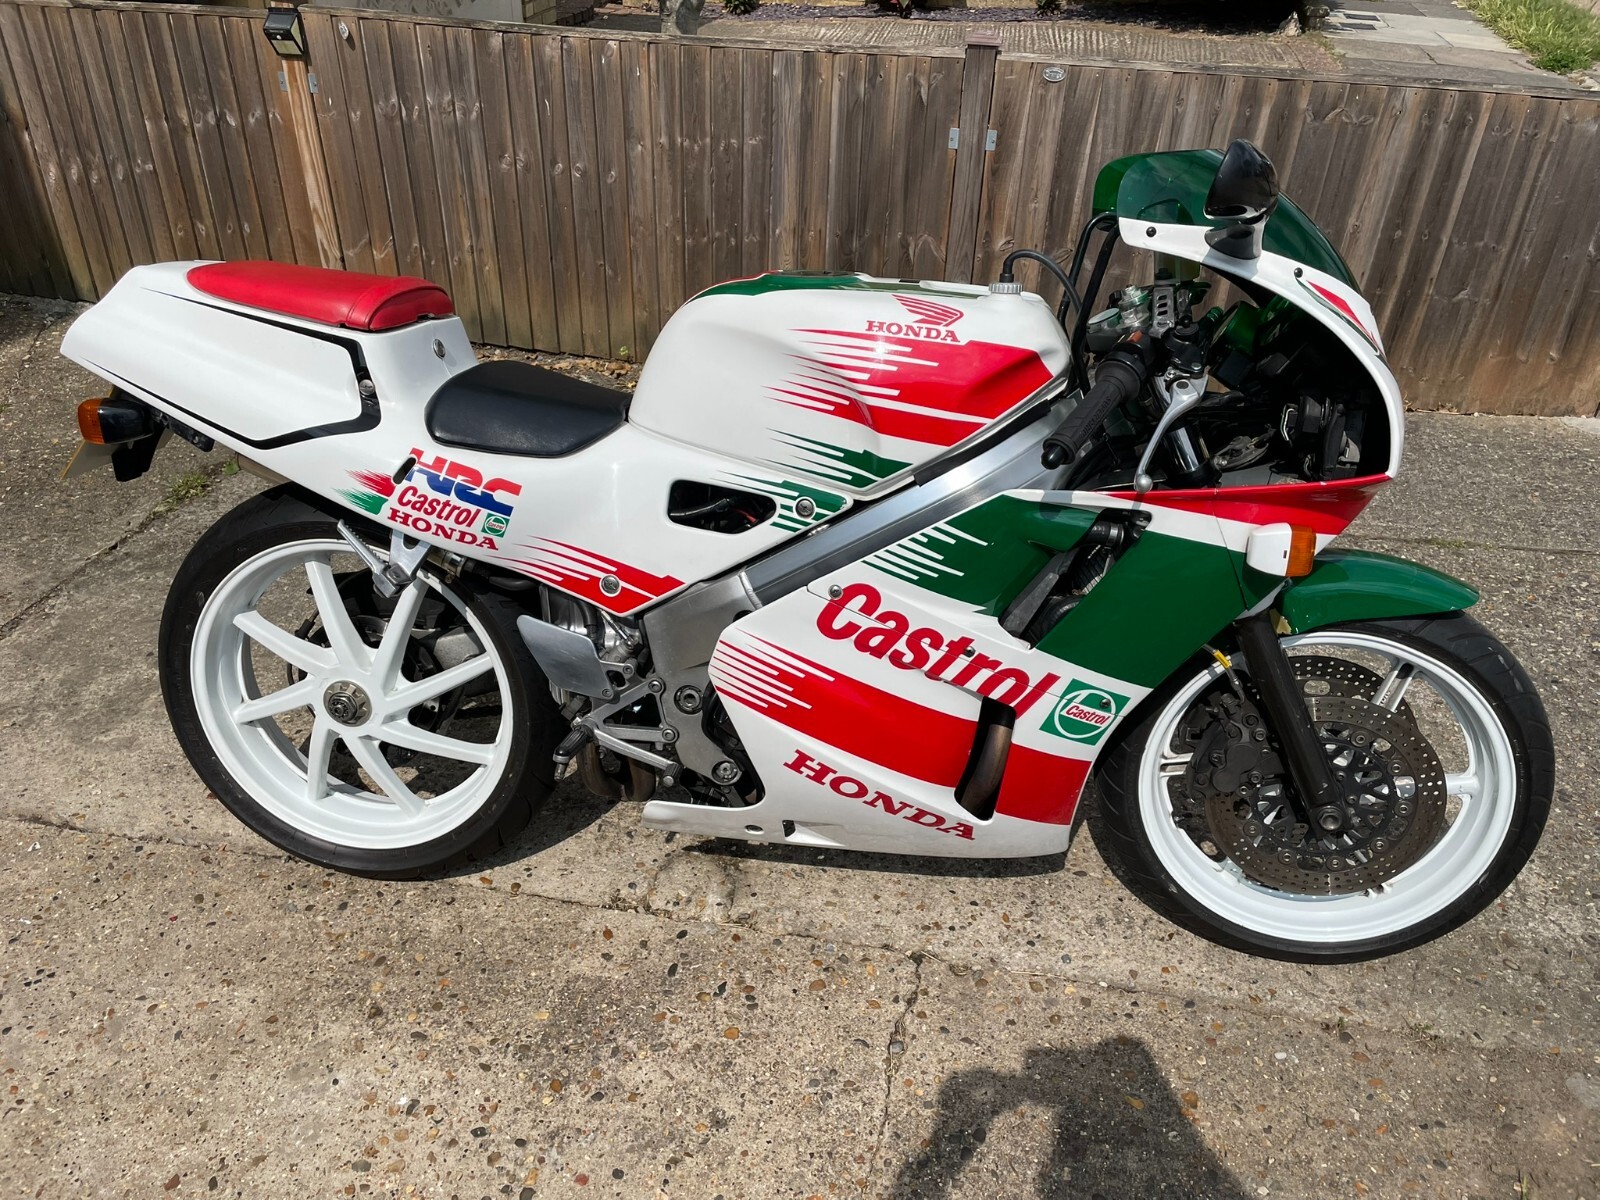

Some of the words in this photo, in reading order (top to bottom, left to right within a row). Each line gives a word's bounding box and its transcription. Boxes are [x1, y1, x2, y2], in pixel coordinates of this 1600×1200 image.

[865, 320, 960, 343] HONDA
[405, 447, 522, 517] HRC
[397, 485, 482, 528] Castrol
[387, 507, 499, 550] HONDA
[816, 582, 1061, 720] Castrol
[1065, 705, 1111, 725] Castrol
[783, 749, 976, 841] HONDA
